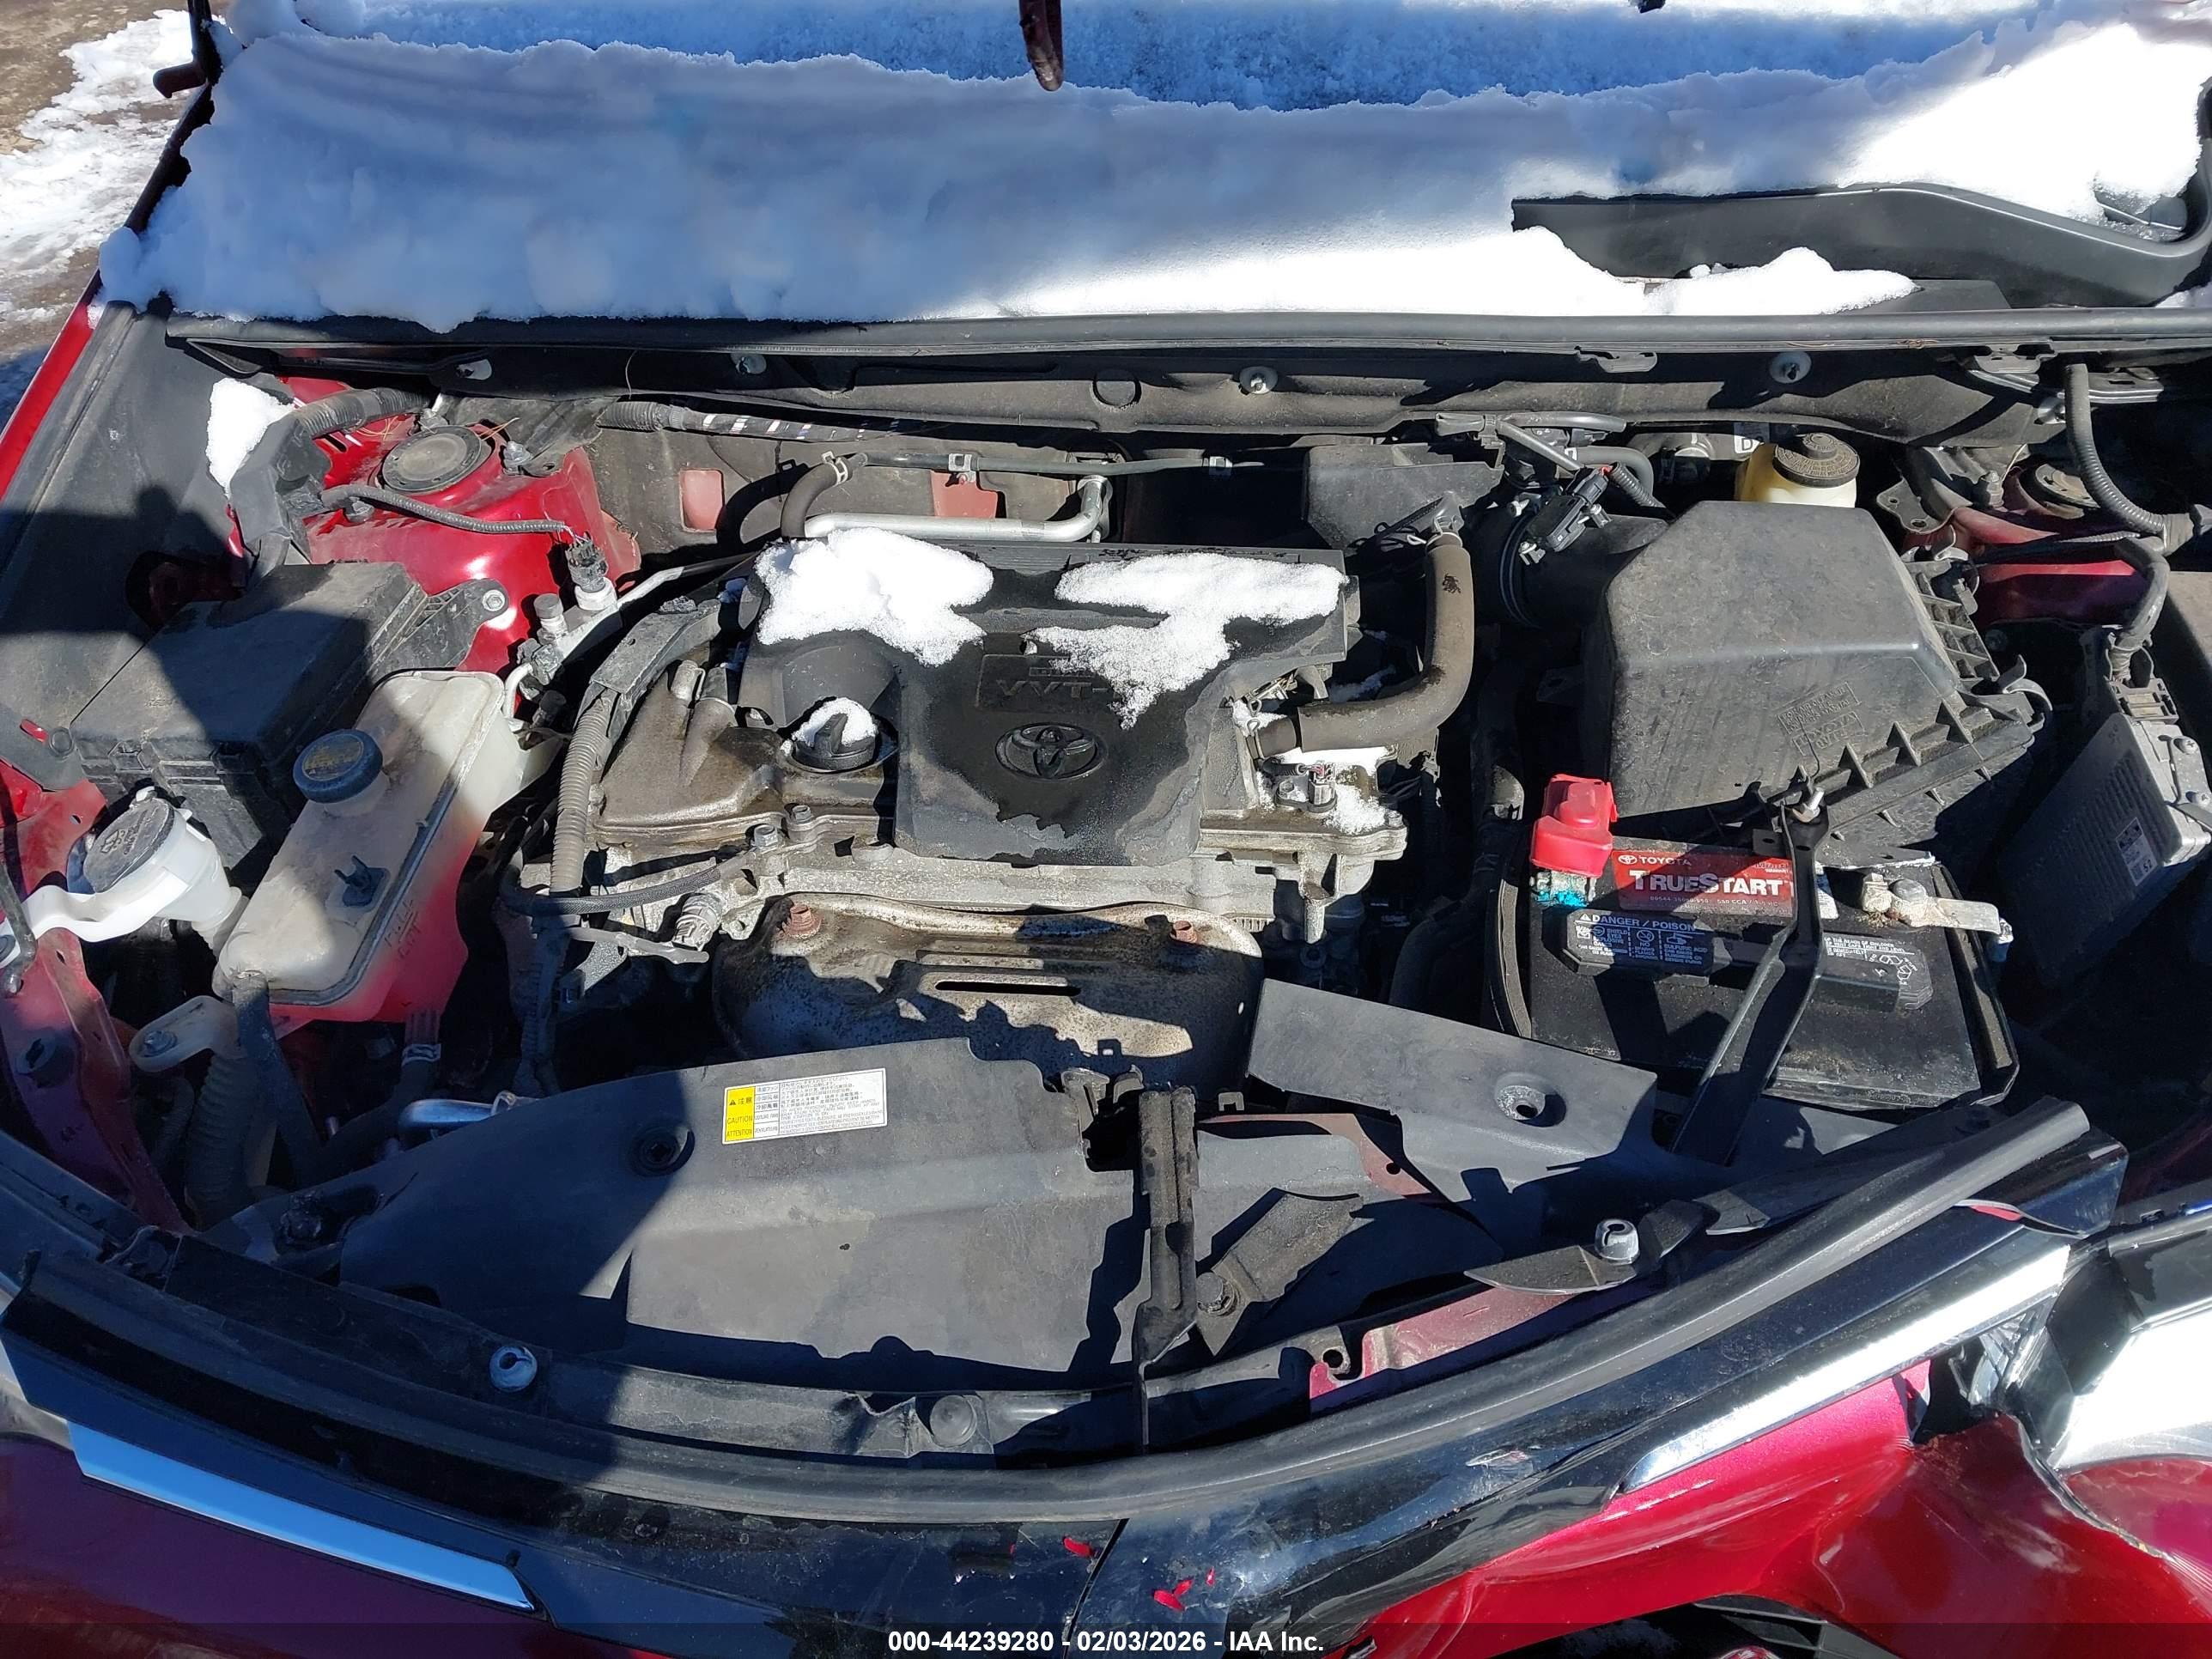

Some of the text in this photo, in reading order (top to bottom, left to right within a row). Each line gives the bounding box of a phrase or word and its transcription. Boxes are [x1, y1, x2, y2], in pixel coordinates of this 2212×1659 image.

[1639, 856, 1691, 866] TOYOTA
[1592, 915, 1639, 927] DANGER
[1652, 921, 1695, 932] POISON
[727, 1115, 752, 1125] CAUTION
[726, 1128, 752, 1138] ATTENTION
